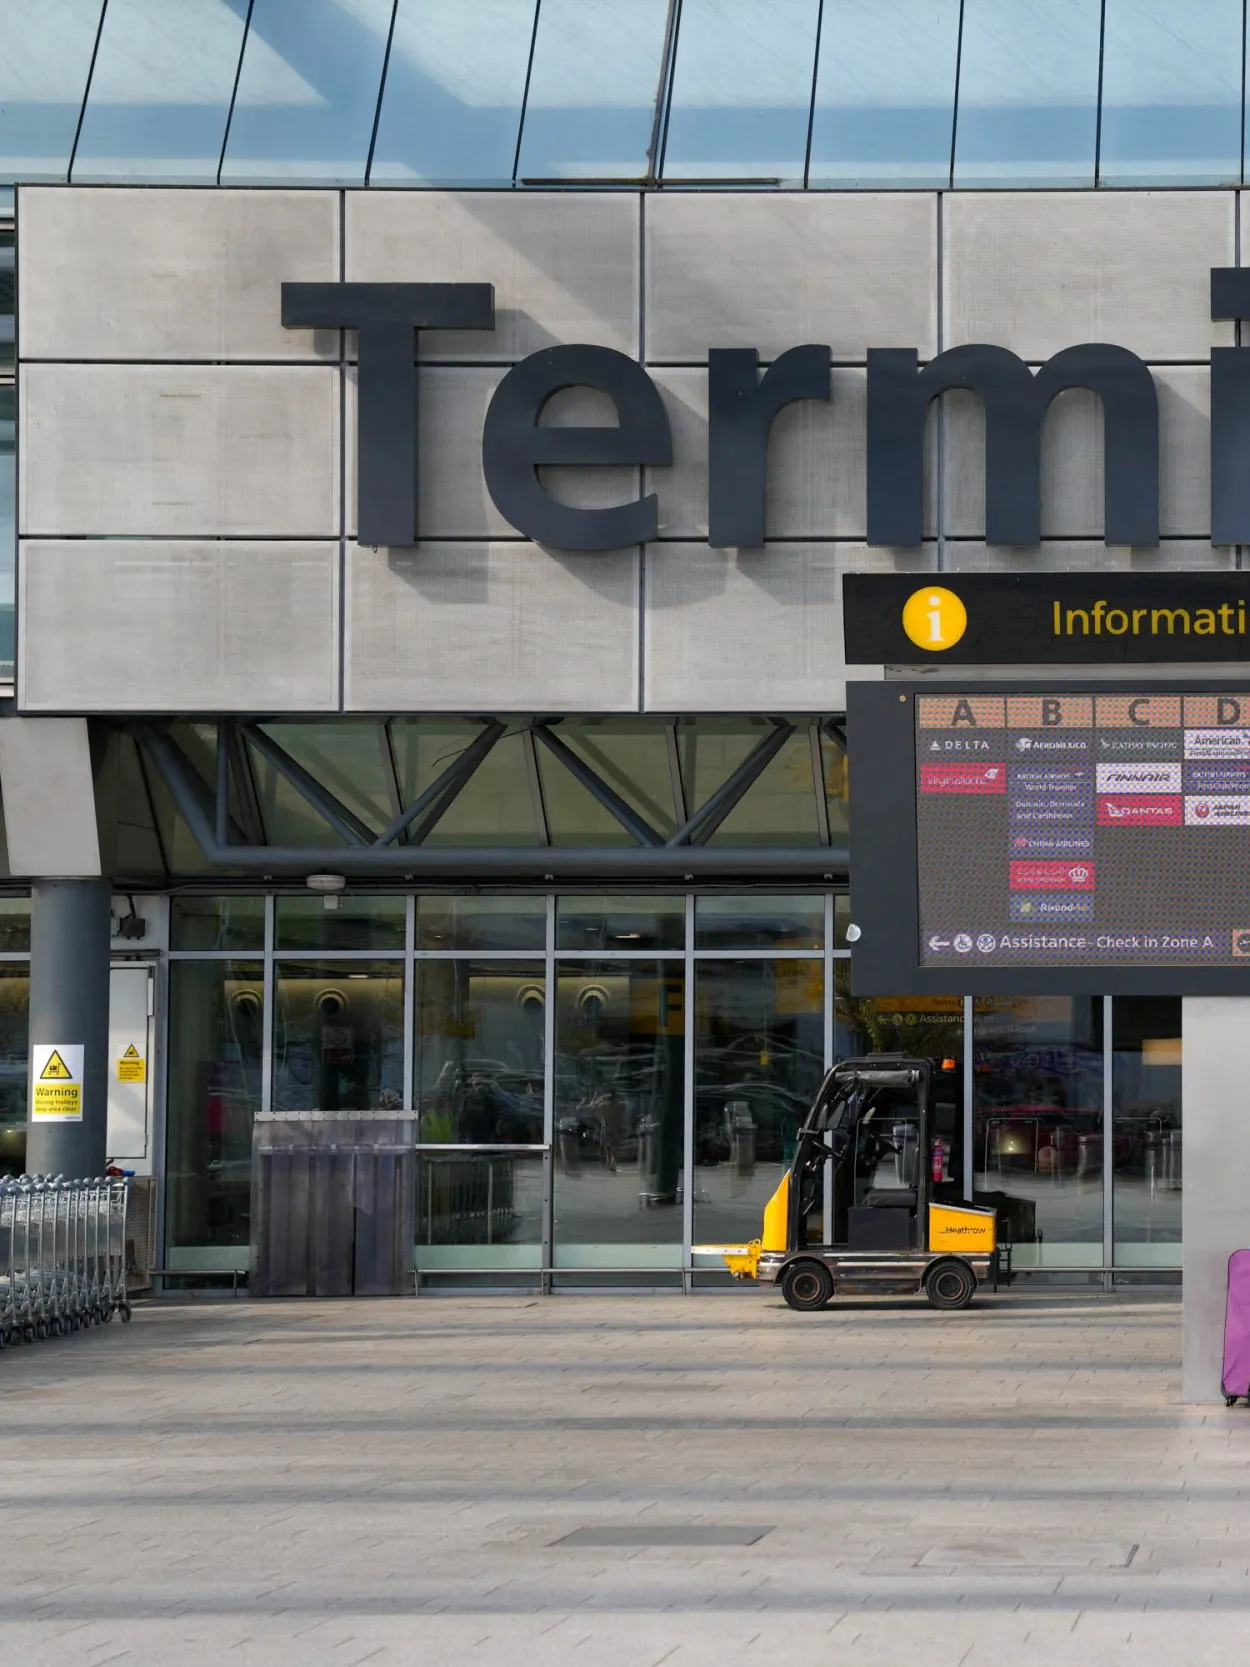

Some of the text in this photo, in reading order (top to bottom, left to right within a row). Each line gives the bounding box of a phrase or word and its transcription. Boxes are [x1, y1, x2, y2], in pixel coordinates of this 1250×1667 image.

[951, 699, 977, 726] A
[1042, 699, 1062, 726] B
[1128, 698, 1150, 726] C
[1217, 698, 1241, 725] D
[944, 740, 990, 750] DELTA
[1194, 736, 1241, 745] American
[1106, 773, 1171, 782] FINNAIR
[1121, 806, 1173, 815] QANTAS
[1028, 840, 1090, 848] CHINA AIRLINES
[1000, 935, 1086, 948] Assistance
[1096, 935, 1138, 948] Check
[1144, 935, 1157, 948] in
[1162, 935, 1198, 948] Zone
[1202, 935, 1214, 948] A
[919, 1013, 964, 1023] Assistanc
[36, 1087, 78, 1098] Warning
